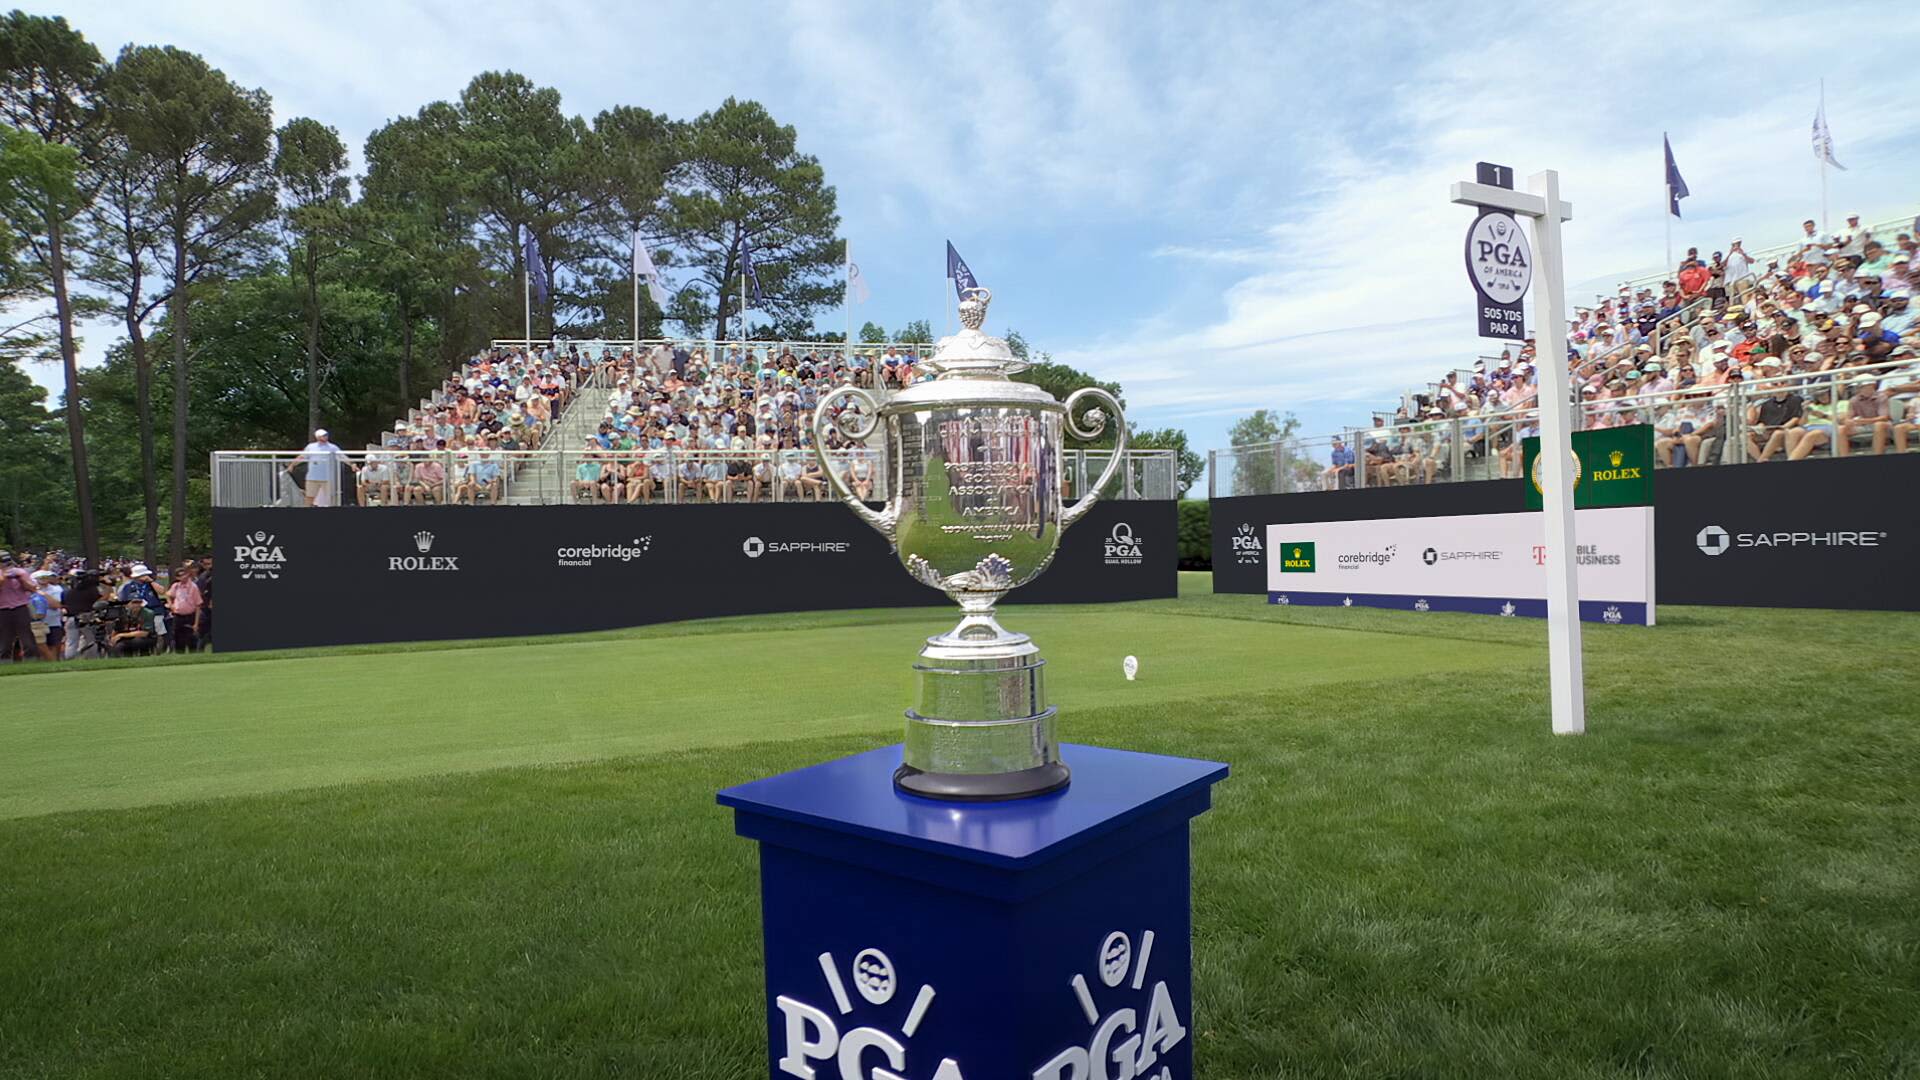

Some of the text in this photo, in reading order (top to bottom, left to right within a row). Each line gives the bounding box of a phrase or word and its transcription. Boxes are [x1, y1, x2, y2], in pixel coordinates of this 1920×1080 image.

[1493, 167, 1501, 186] 1
[1477, 240, 1528, 268] PGA
[1495, 268, 1523, 278] AMERICA
[1484, 307, 1522, 322] 505 YDS
[1490, 322, 1518, 336] PAR 4
[1592, 467, 1641, 482] ROLEX
[1232, 536, 1264, 550] PGA
[1736, 531, 1881, 547] SAPPHIRE
[233, 545, 288, 562] PGA
[557, 544, 642, 562] corebridge
[768, 542, 847, 553] SAPPHIRE
[1104, 545, 1143, 557] PGA
[387, 556, 460, 571] ROLEX
[558, 558, 592, 566] financial
[1284, 559, 1311, 568] ROLEX
[1338, 551, 1391, 566] corebridge
[1440, 551, 1502, 561] SAPPHIRE
[776, 995, 964, 1080] PG
